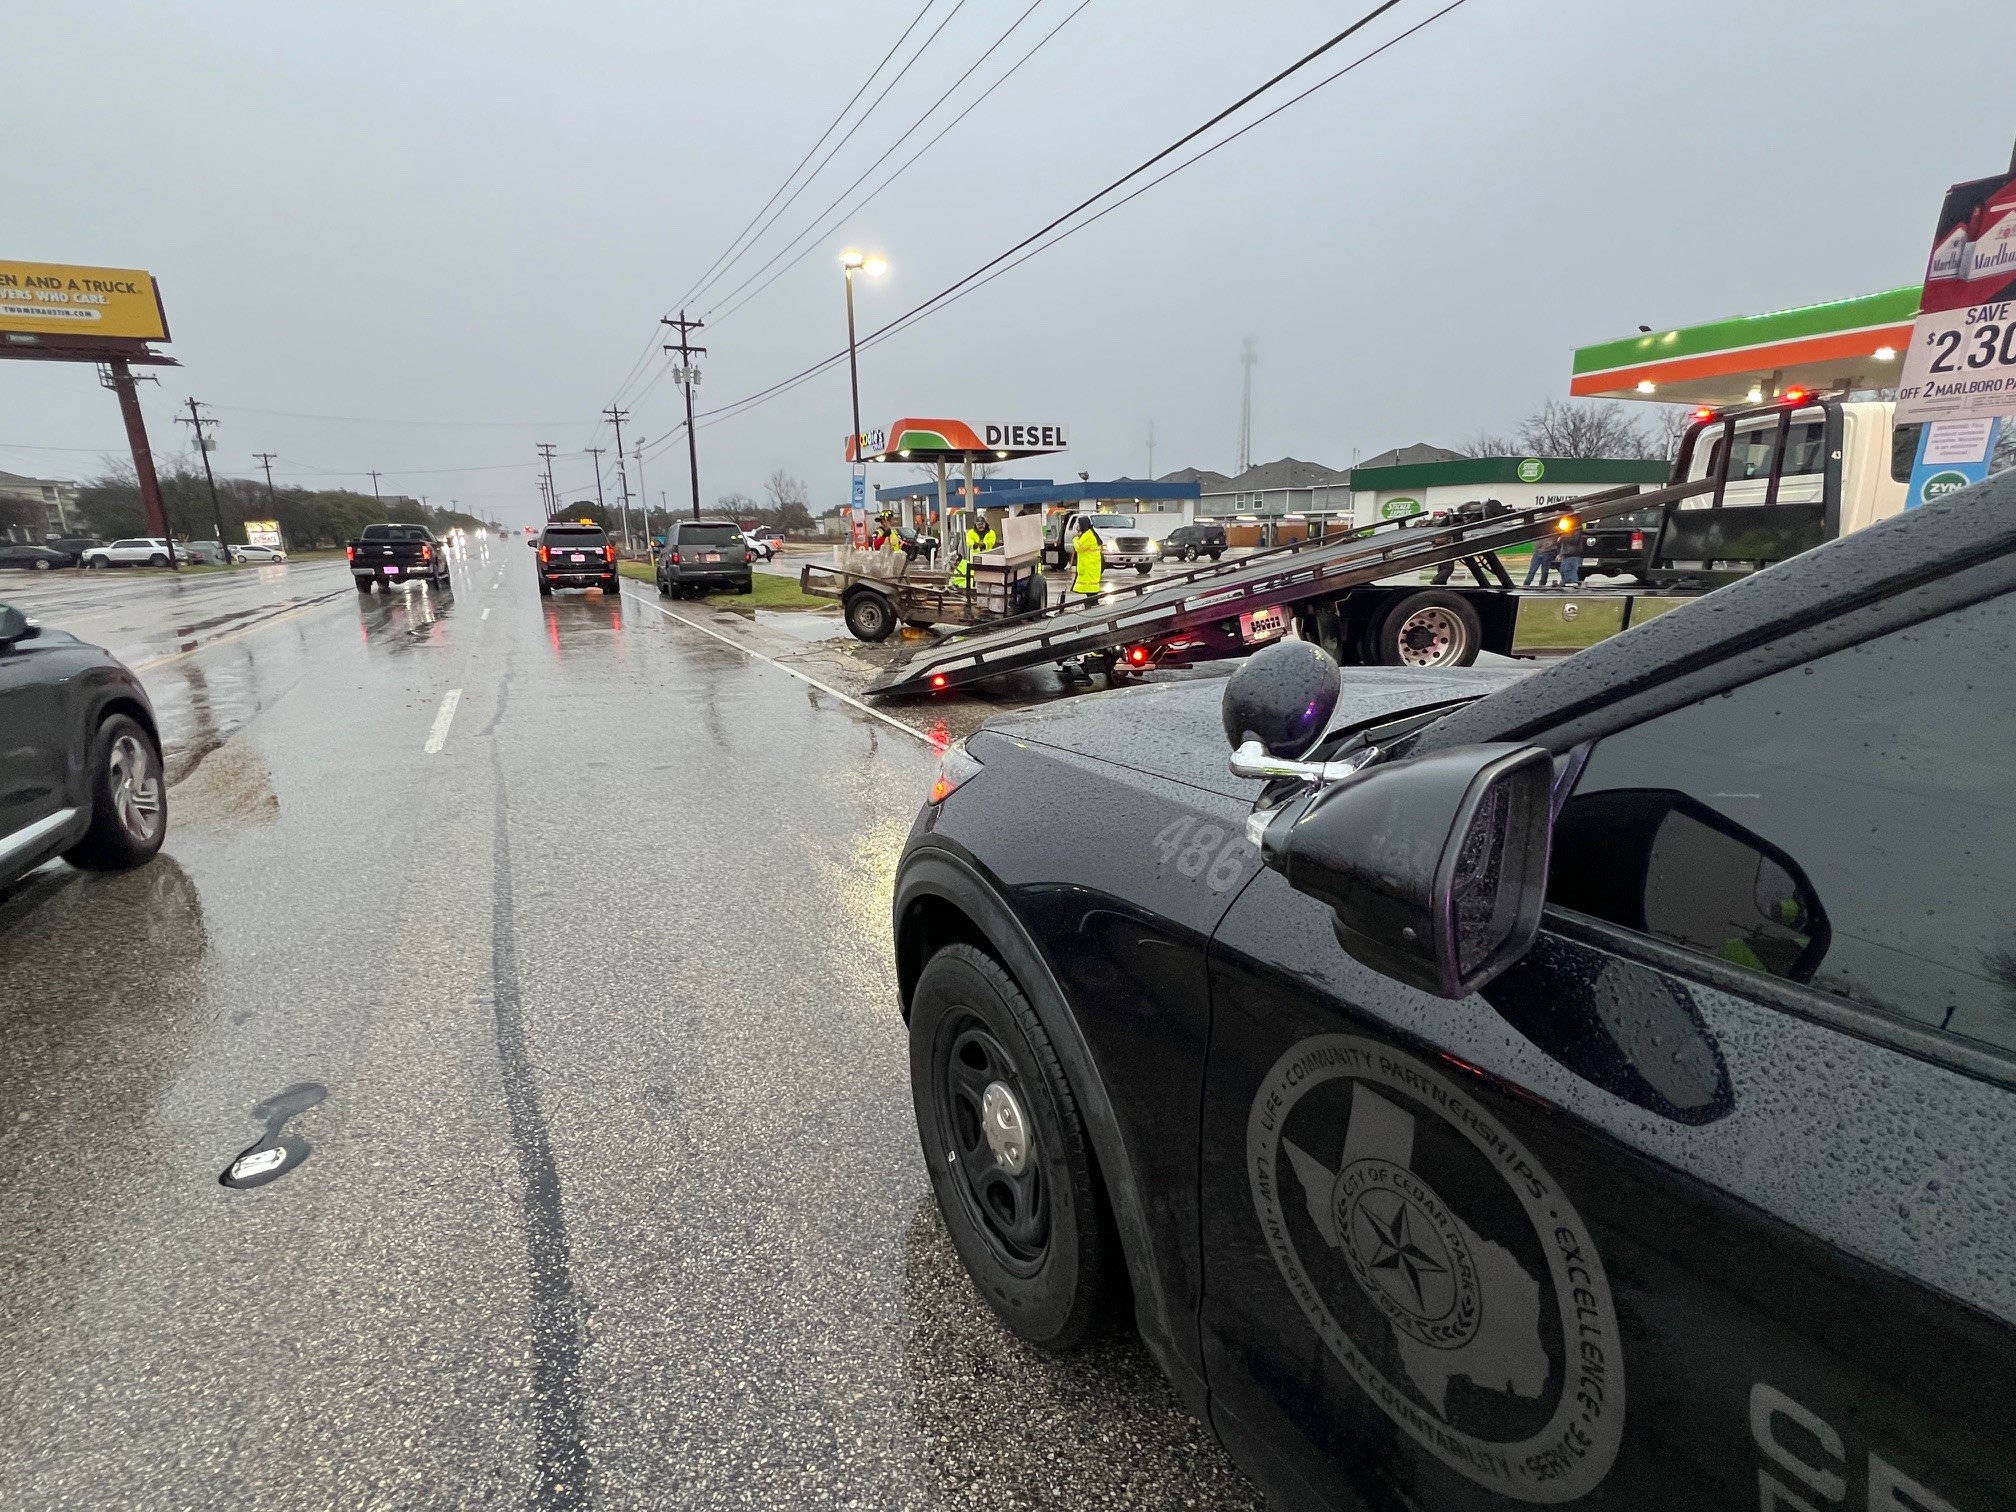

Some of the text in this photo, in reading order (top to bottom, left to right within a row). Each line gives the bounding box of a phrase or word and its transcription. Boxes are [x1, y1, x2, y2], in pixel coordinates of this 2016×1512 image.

[1974, 242, 2016, 269] Marlbo
[25, 275, 62, 289] AND
[68, 279, 81, 291] A
[35, 290, 70, 303] WHO
[4, 306, 92, 318] TWOMENAUSTIN.COM
[1965, 303, 2012, 325] SAVE
[1900, 387, 1921, 400] OFF
[1923, 381, 1935, 398] 2
[1935, 379, 2003, 397] MARLBORO
[859, 429, 885, 448] oodie's
[986, 425, 1067, 446] DIESEL
[1831, 450, 1842, 460] 43
[1929, 483, 1964, 494] ZYN
[1535, 495, 1545, 506] 10
[1152, 814, 1257, 893] 486
[1260, 1048, 1605, 1418] LIFE COMMUNITY PARTNERSHIPS EXCELLENCE
[1342, 1168, 1474, 1291] CITY OF CEDAR PARK
[1256, 1155, 1594, 1482] LAW INTEGRITY ACCOUNTABILITY SERVICE
